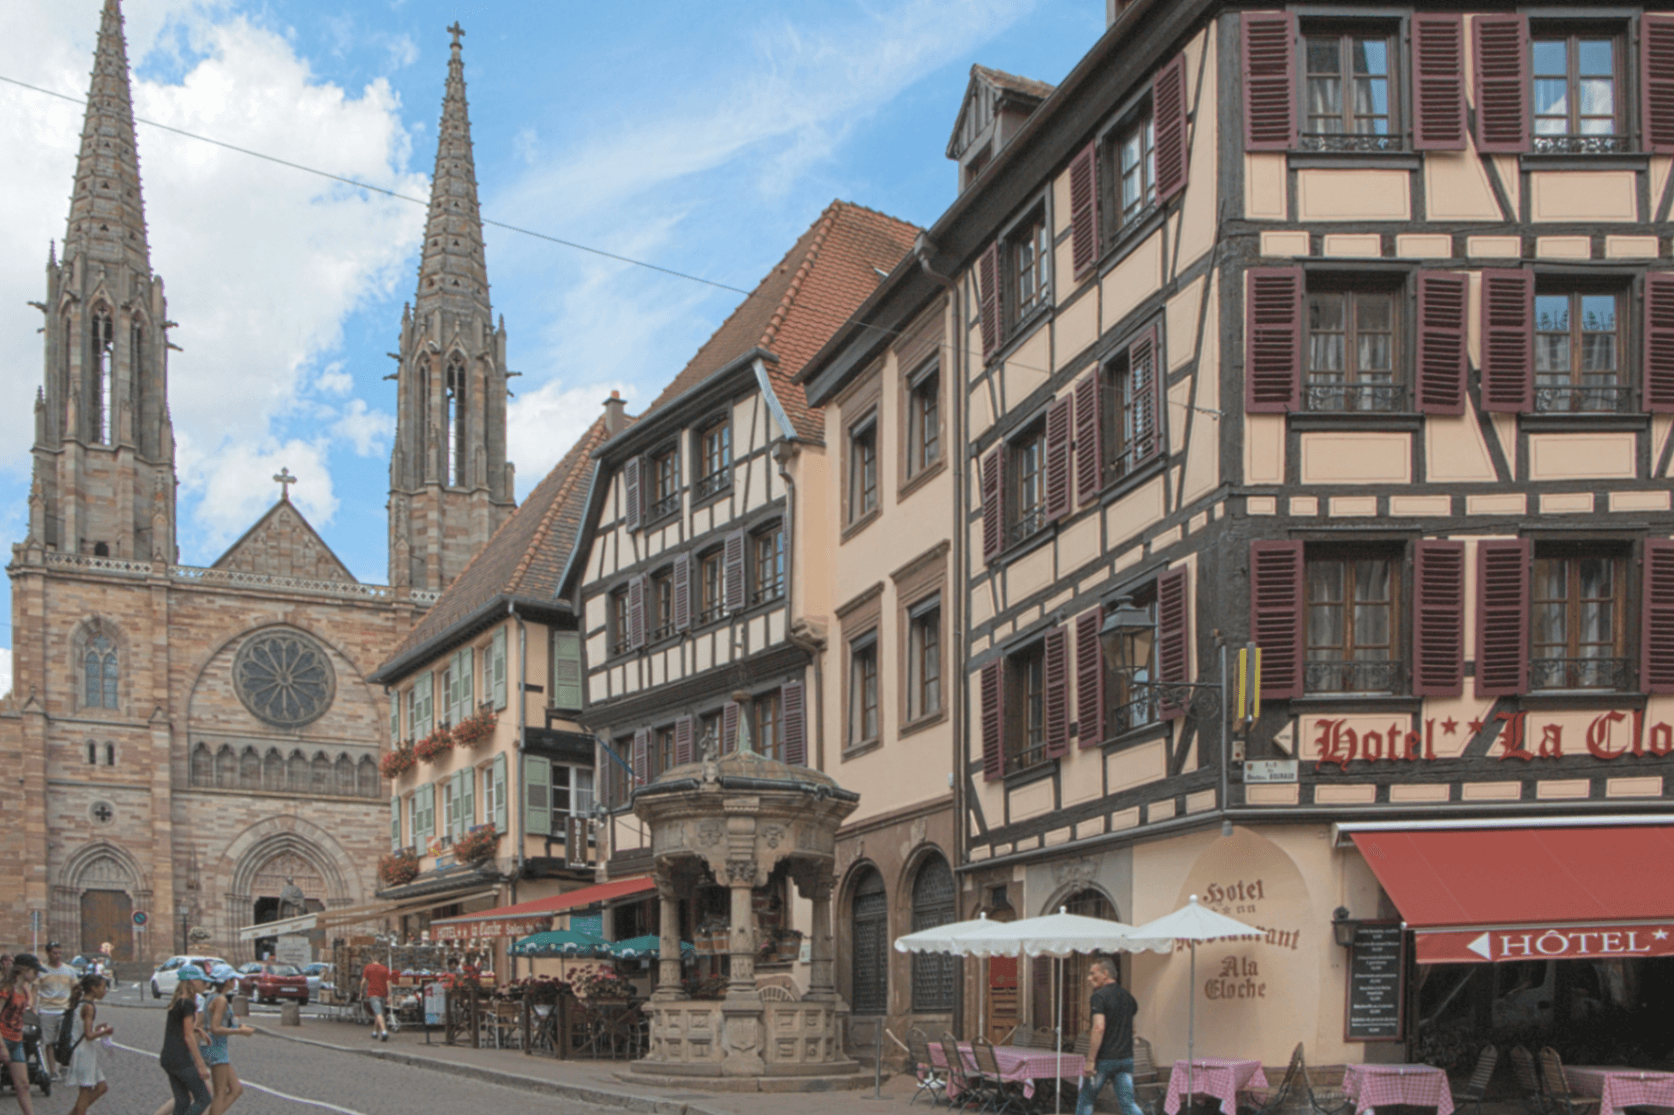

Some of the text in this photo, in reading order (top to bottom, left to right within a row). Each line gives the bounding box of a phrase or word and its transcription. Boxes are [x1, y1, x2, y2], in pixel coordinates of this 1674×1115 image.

[1314, 710, 1673, 771] Hotel La Clo
[1203, 879, 1264, 904] Hotel
[1500, 930, 1651, 956] HÔTEL
[1204, 978, 1266, 1000] Cloche
